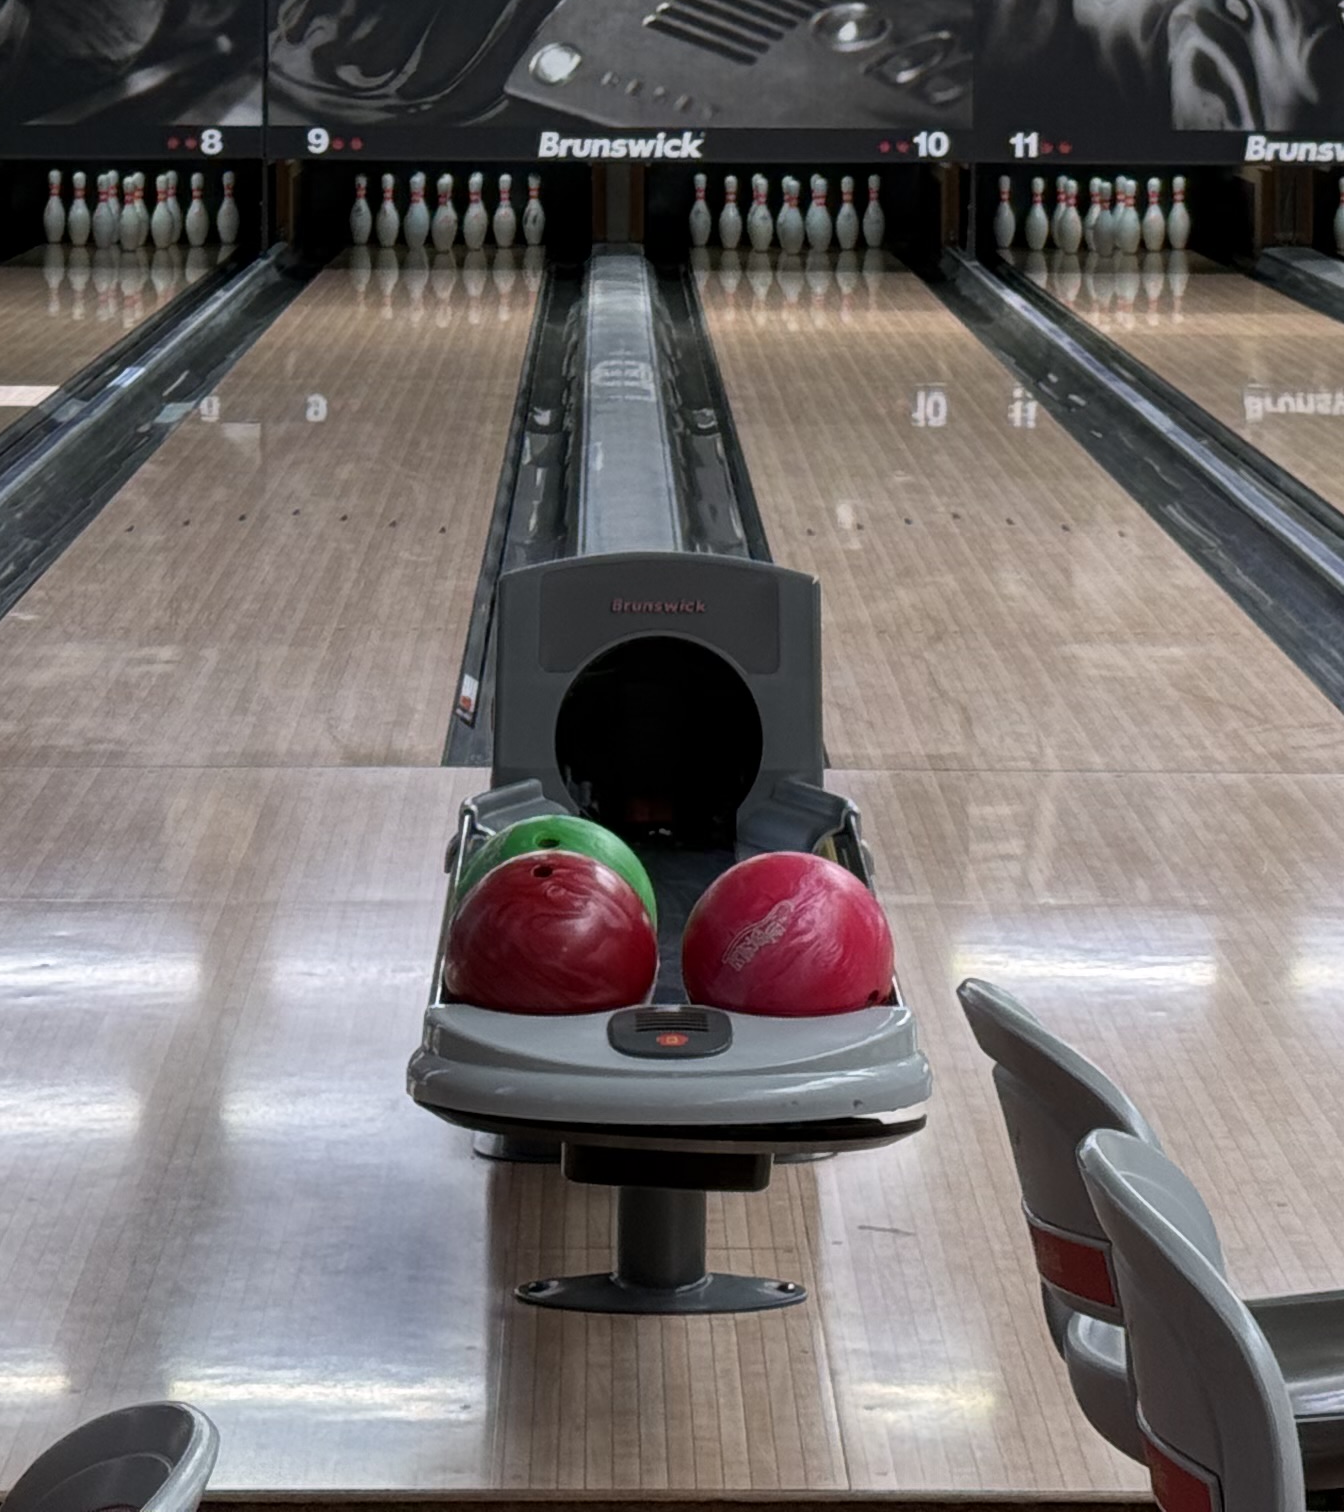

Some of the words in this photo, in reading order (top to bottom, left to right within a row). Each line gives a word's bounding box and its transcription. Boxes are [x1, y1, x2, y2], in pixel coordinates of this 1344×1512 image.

[200, 129, 223, 155] 8
[307, 128, 330, 154] 9
[538, 131, 704, 159] Brunswick
[913, 131, 950, 157] 10
[1009, 132, 1039, 158] 11
[611, 597, 706, 613] Brunswick
